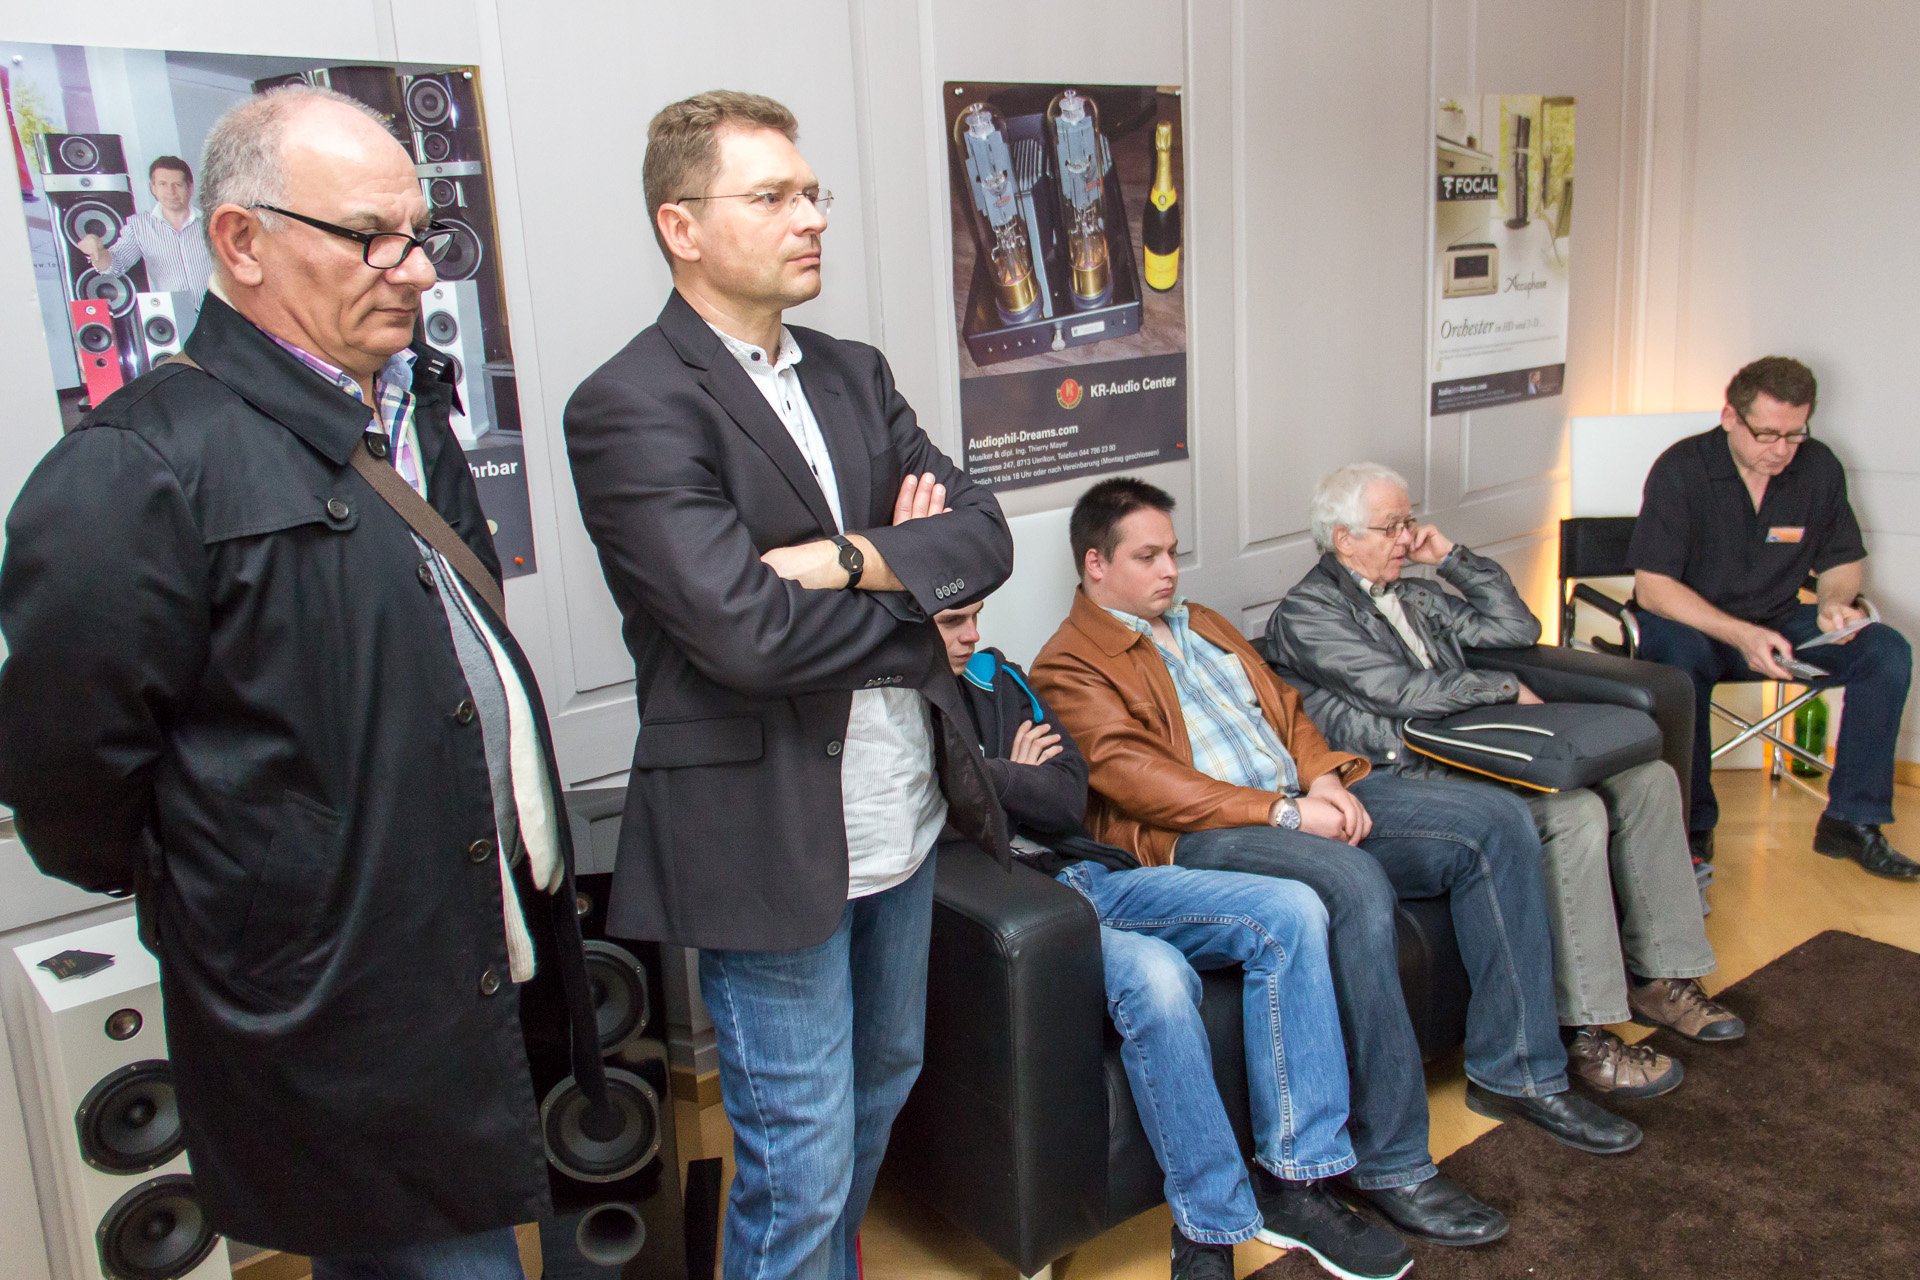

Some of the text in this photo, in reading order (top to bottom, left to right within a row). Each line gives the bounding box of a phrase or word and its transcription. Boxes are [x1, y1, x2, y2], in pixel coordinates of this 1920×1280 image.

[1456, 177, 1497, 194] FOCAL
[1441, 319, 1494, 339] Orchester
[1090, 380, 1140, 398] KR-Audio
[1142, 376, 1176, 390] Center
[968, 424, 1079, 450] Audiophil-Dreams.com
[968, 452, 993, 462] Musiker
[994, 451, 1000, 459] &
[1015, 448, 1027, 456] Ing.
[1028, 444, 1048, 453] Thierry
[1050, 441, 1068, 450] Mayer
[969, 464, 1002, 475] Seestrasse
[1017, 459, 1031, 467] 8713
[1058, 451, 1078, 460] Telefon
[1079, 448, 1090, 457] 044
[1002, 474, 1012, 482] bis
[1013, 472, 1020, 480] 18
[1020, 470, 1032, 479] Uhr
[1033, 468, 1046, 477] oder
[1047, 465, 1062, 474] nach
[1063, 459, 1100, 472] Vereinbarung
[1100, 454, 1124, 466] (Montag
[1125, 449, 1160, 461] geschlossen)
